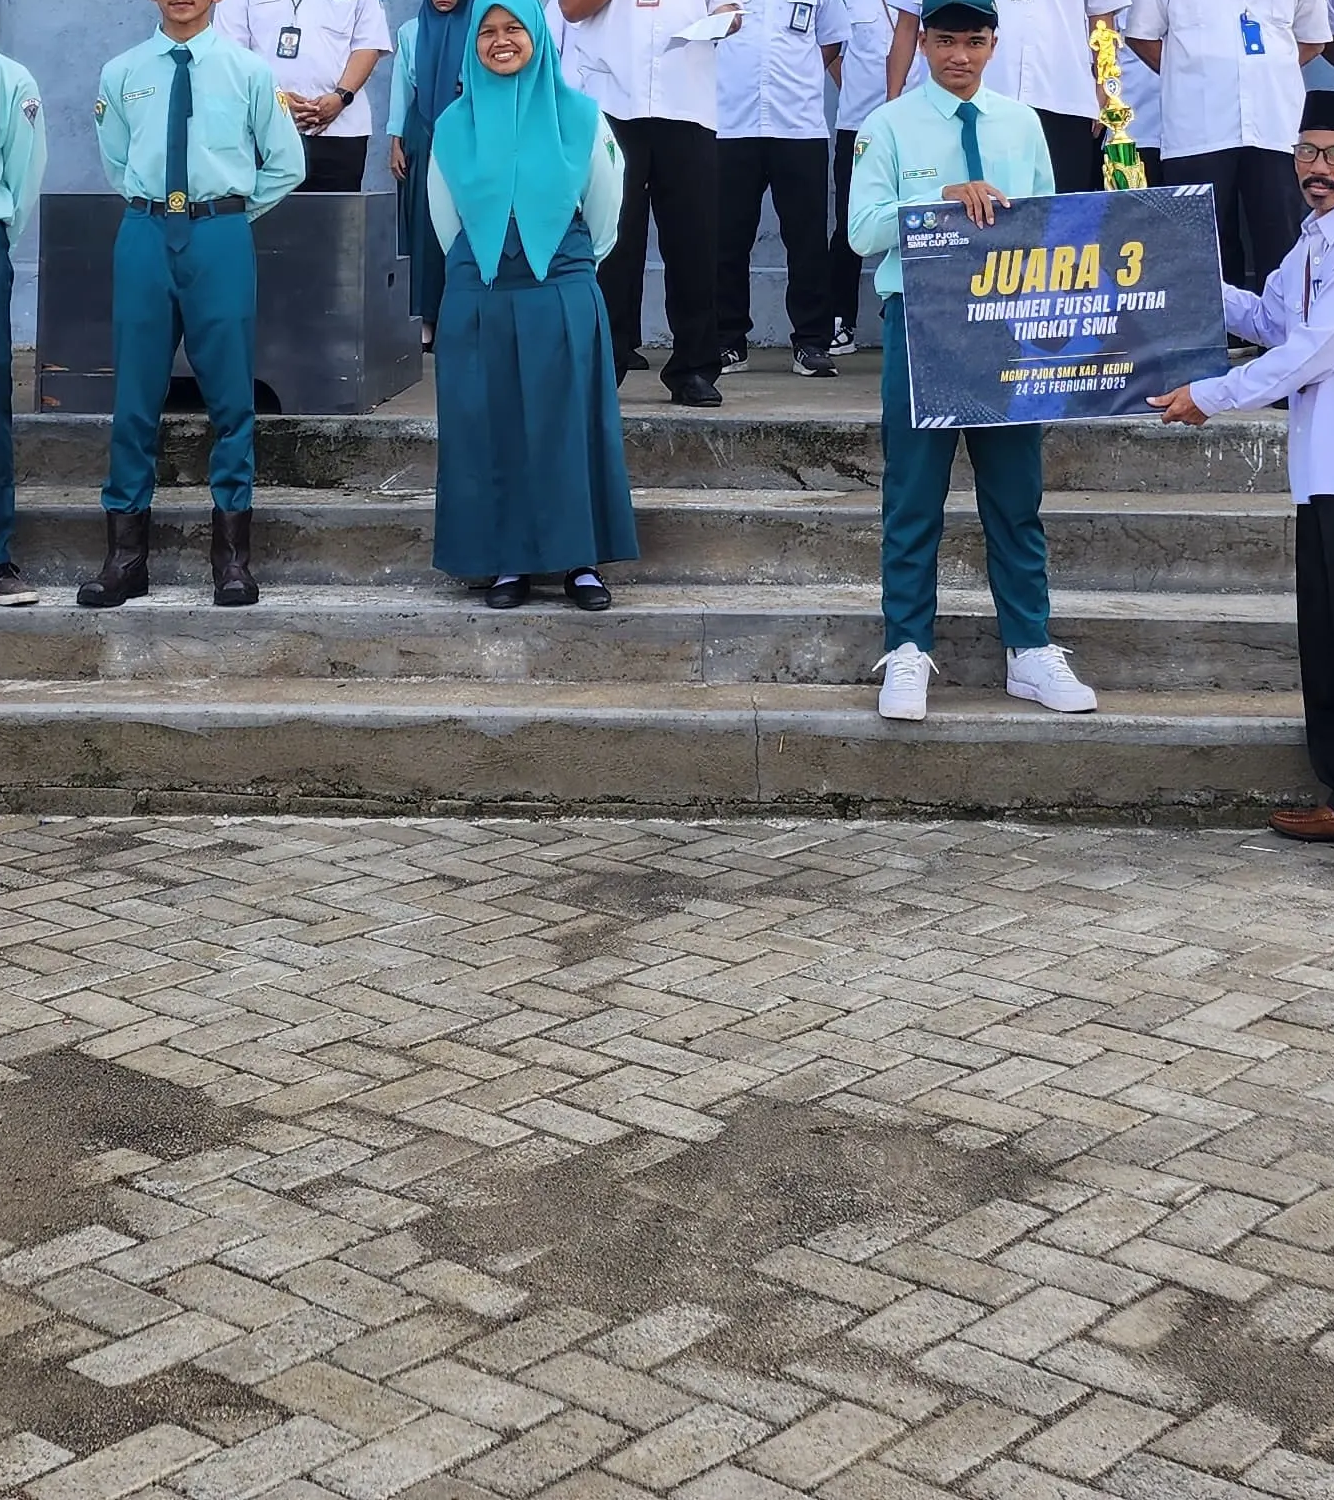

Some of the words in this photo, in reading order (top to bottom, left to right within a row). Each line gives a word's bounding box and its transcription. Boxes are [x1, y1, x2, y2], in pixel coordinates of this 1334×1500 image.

[907, 241, 927, 249] SMK
[928, 239, 947, 248] CUP
[948, 237, 970, 246] 2025
[935, 231, 959, 240] PJOK
[970, 243, 1100, 297] JUARA
[1116, 241, 1144, 287] 3
[967, 298, 1049, 322] TURNAMEN
[1055, 294, 1111, 316] FUTSAL
[1117, 290, 1166, 312] PUTRA
[1014, 318, 1078, 341] TINGKAT
[1082, 315, 1118, 336] SMK
[1000, 369, 1029, 382] MGMP
[1030, 367, 1056, 380] PJOK
[1057, 365, 1077, 379] SMK
[1102, 361, 1134, 375] KEDIRI
[1048, 377, 1097, 394] FEBRUARI
[1099, 376, 1127, 390] 2025
